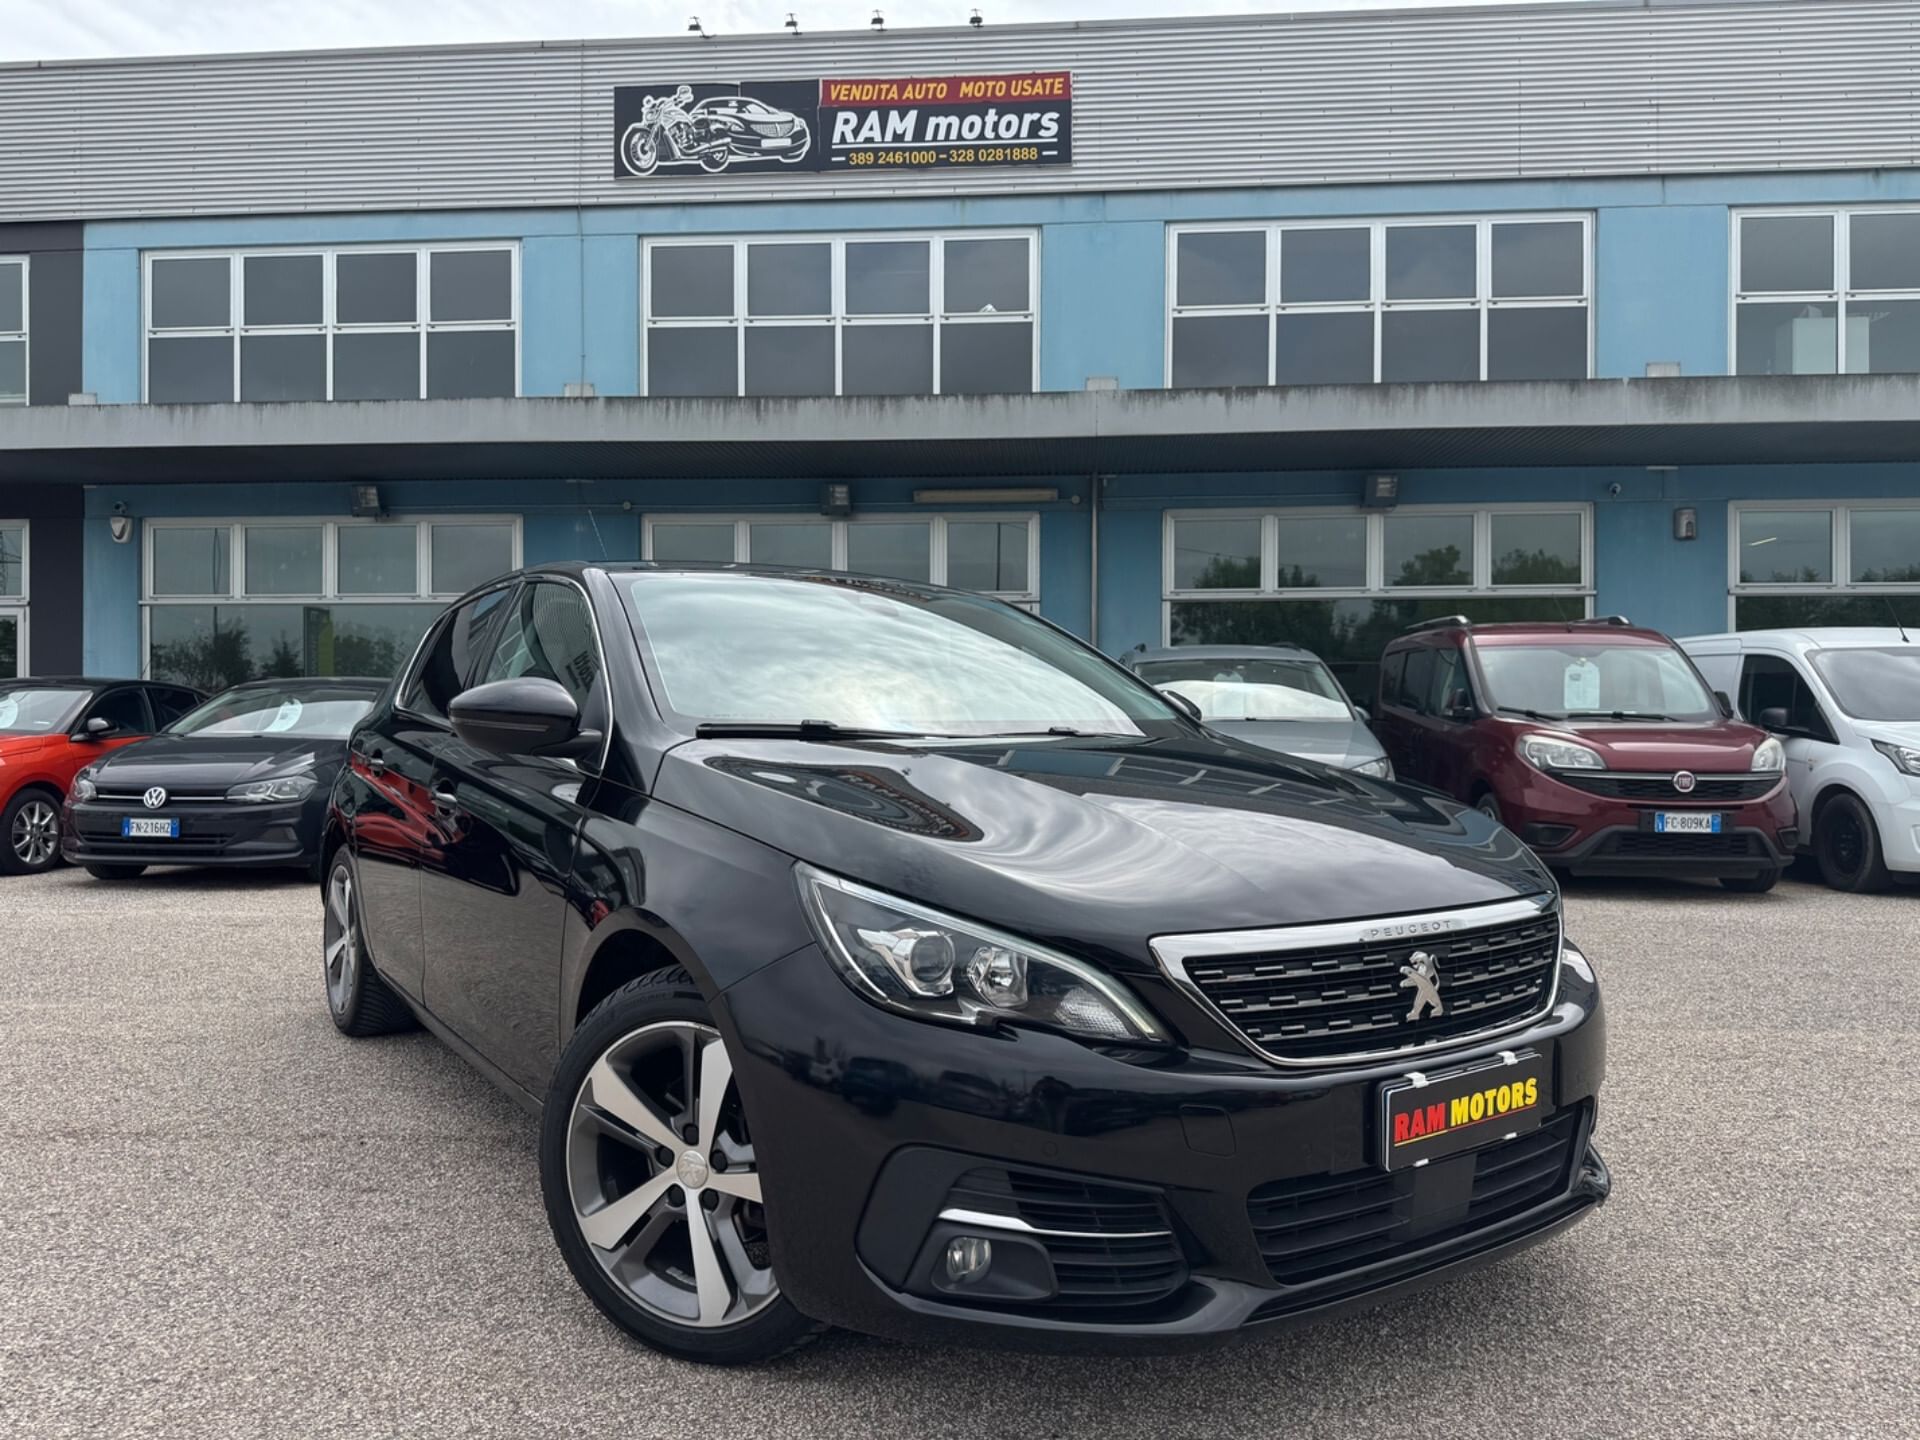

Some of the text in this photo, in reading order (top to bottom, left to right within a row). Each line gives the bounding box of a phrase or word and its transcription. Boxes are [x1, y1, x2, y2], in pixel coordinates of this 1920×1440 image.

[830, 78, 1065, 101] VENDITA AUTO MOTO USATE
[831, 108, 1060, 144] RAM motors
[848, 152, 874, 165] 389
[878, 150, 937, 165] 2461000
[948, 149, 975, 162] 328
[978, 147, 1038, 162] 0281888
[1370, 920, 1451, 938] PEUGEOT
[1394, 1077, 1538, 1142] RAM MOTORS
